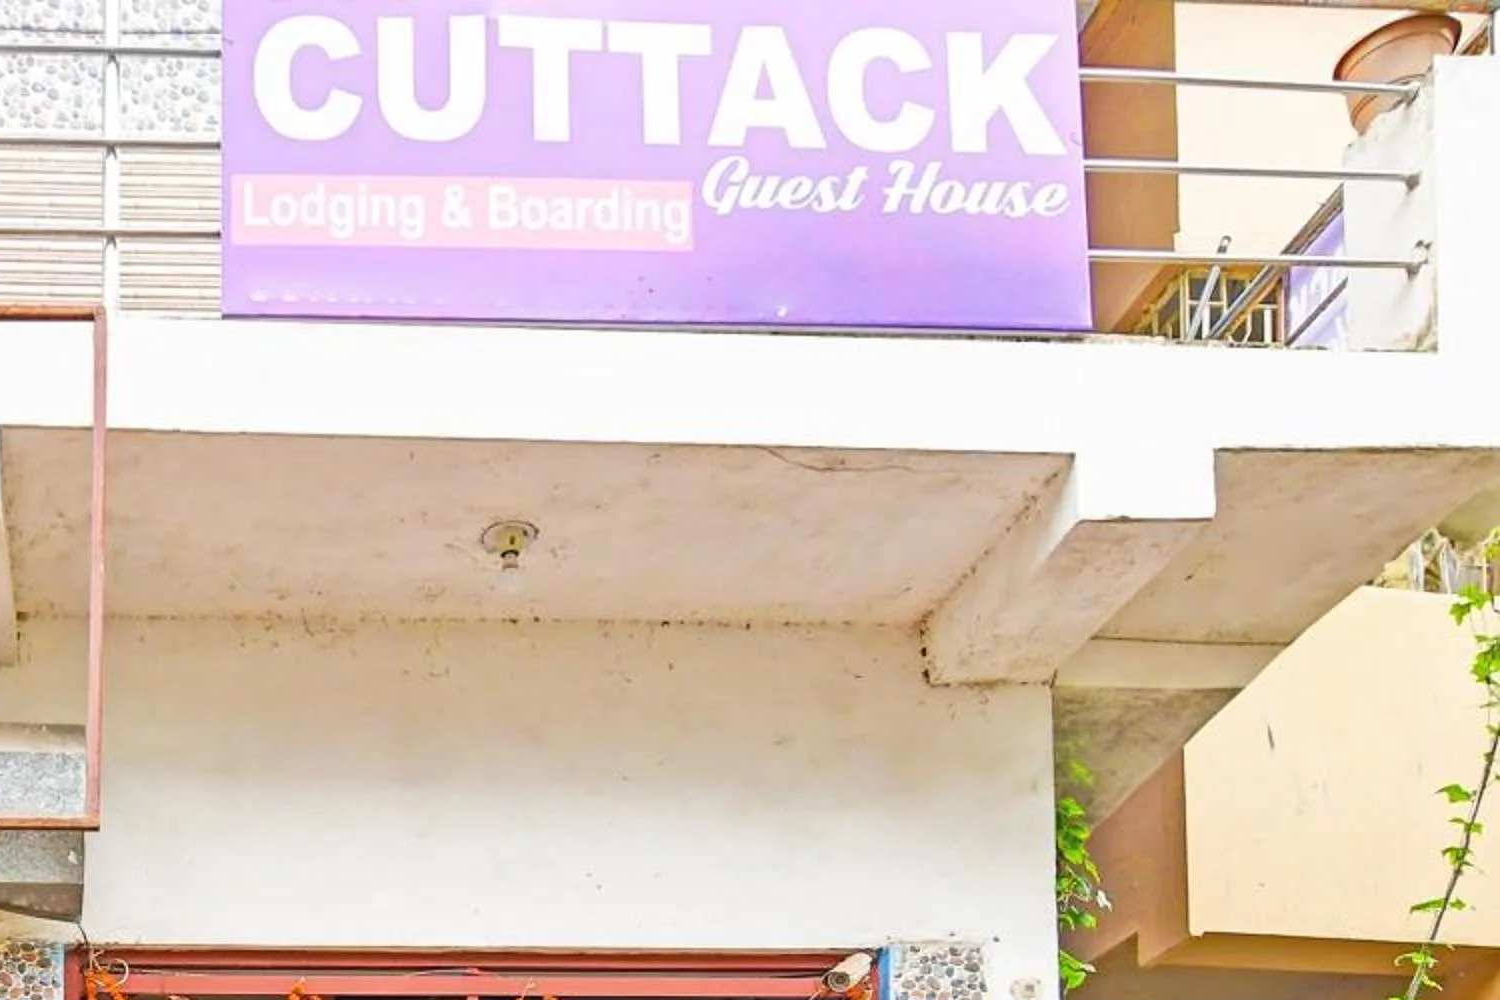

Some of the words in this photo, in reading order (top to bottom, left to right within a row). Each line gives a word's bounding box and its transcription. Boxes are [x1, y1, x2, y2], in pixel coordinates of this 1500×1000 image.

[252, 13, 1069, 156] CUTTACK
[244, 180, 426, 238] Lodging
[440, 185, 474, 227] &
[487, 184, 692, 241] Boarding
[702, 155, 866, 217] Guest
[878, 160, 1071, 219] House
